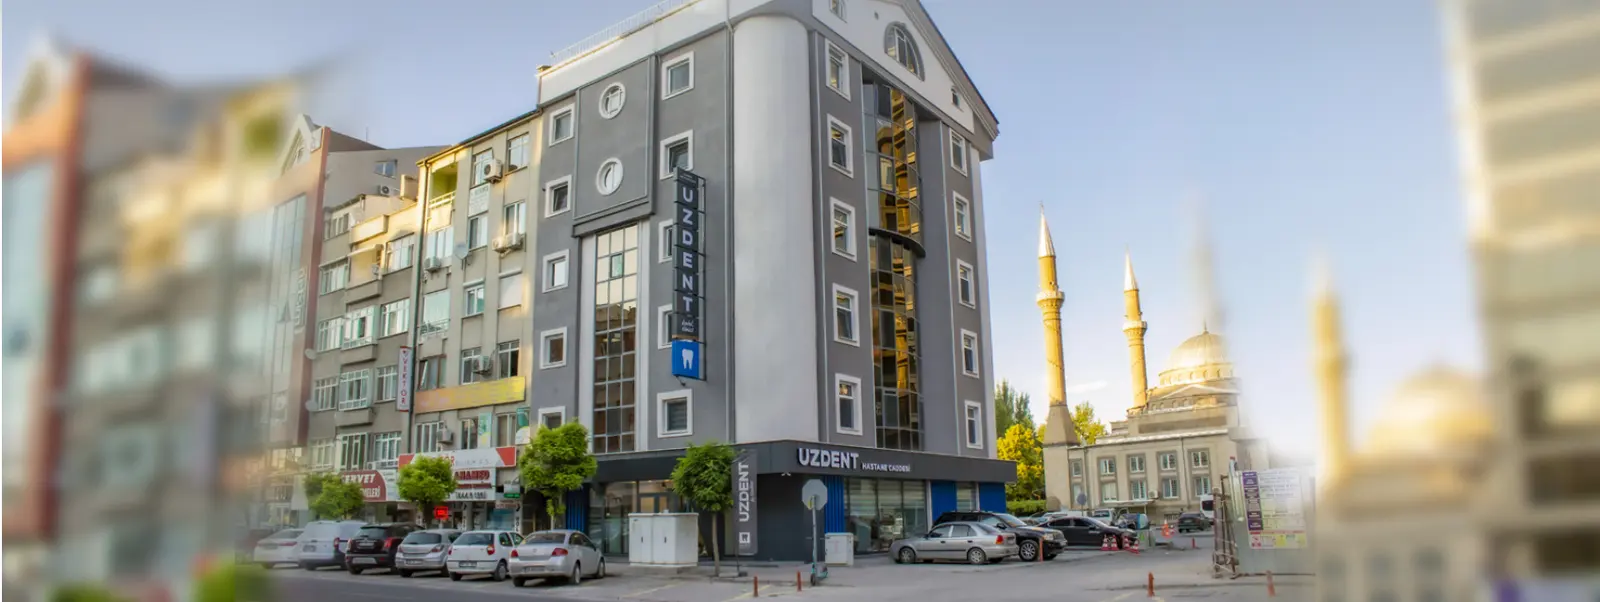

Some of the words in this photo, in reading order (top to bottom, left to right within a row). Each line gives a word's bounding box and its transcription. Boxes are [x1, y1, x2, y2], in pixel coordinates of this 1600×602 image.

[682, 186, 694, 312] UZDENT
[798, 447, 859, 470] UZDENT
[862, 462, 888, 472] HASTANE
[738, 462, 750, 522] UZDENT
